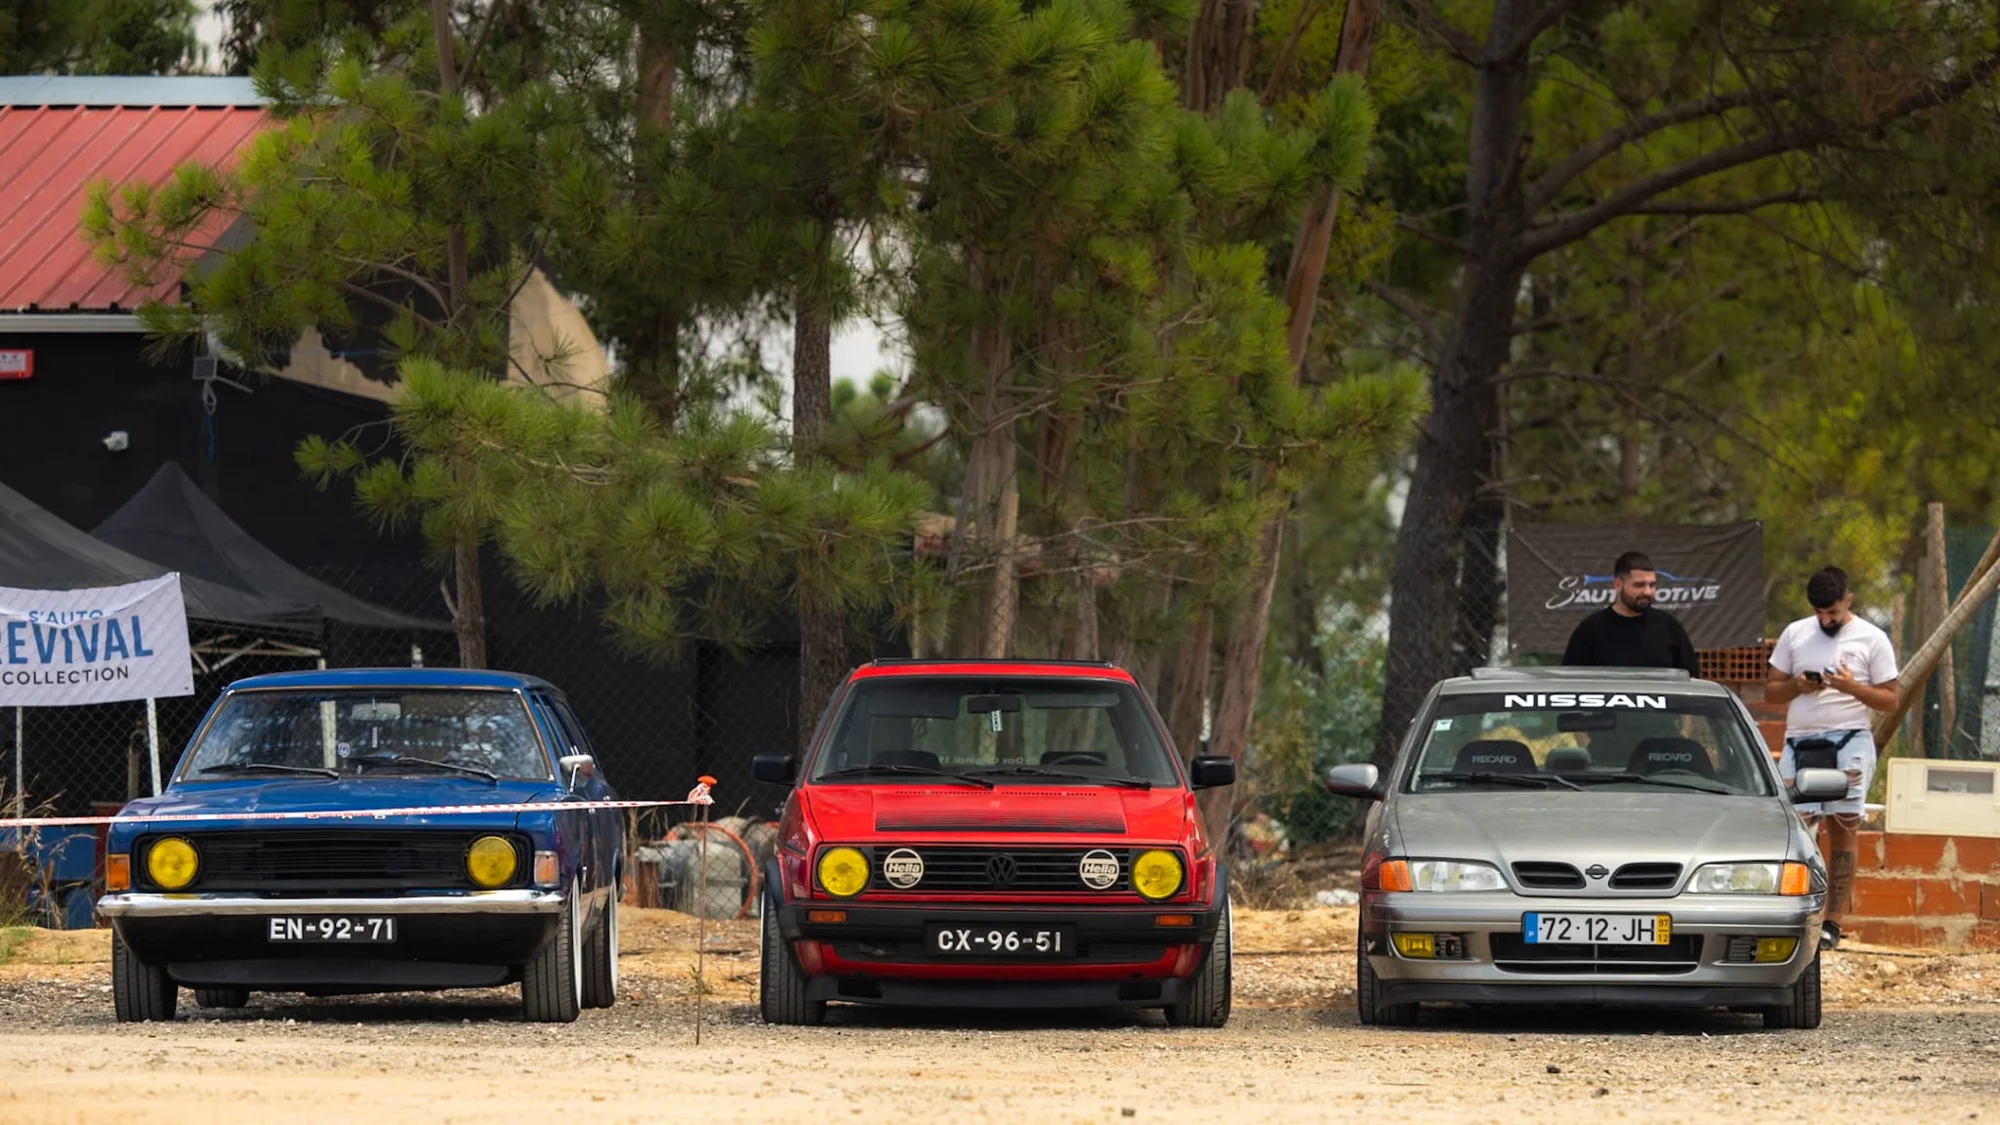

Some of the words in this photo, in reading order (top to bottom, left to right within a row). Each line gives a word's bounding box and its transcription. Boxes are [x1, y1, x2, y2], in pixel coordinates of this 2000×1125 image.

[0, 615, 154, 664] EVIVAL
[2, 666, 129, 685] COLLECTION
[1504, 694, 1667, 709] NISSAN
[1472, 754, 1517, 764] RECARO
[1649, 752, 1692, 763] RECARO
[888, 863, 920, 873] Hella
[1083, 864, 1116, 874] Hella
[270, 917, 393, 940] EN-92-71
[938, 929, 1061, 952] CX-96-51
